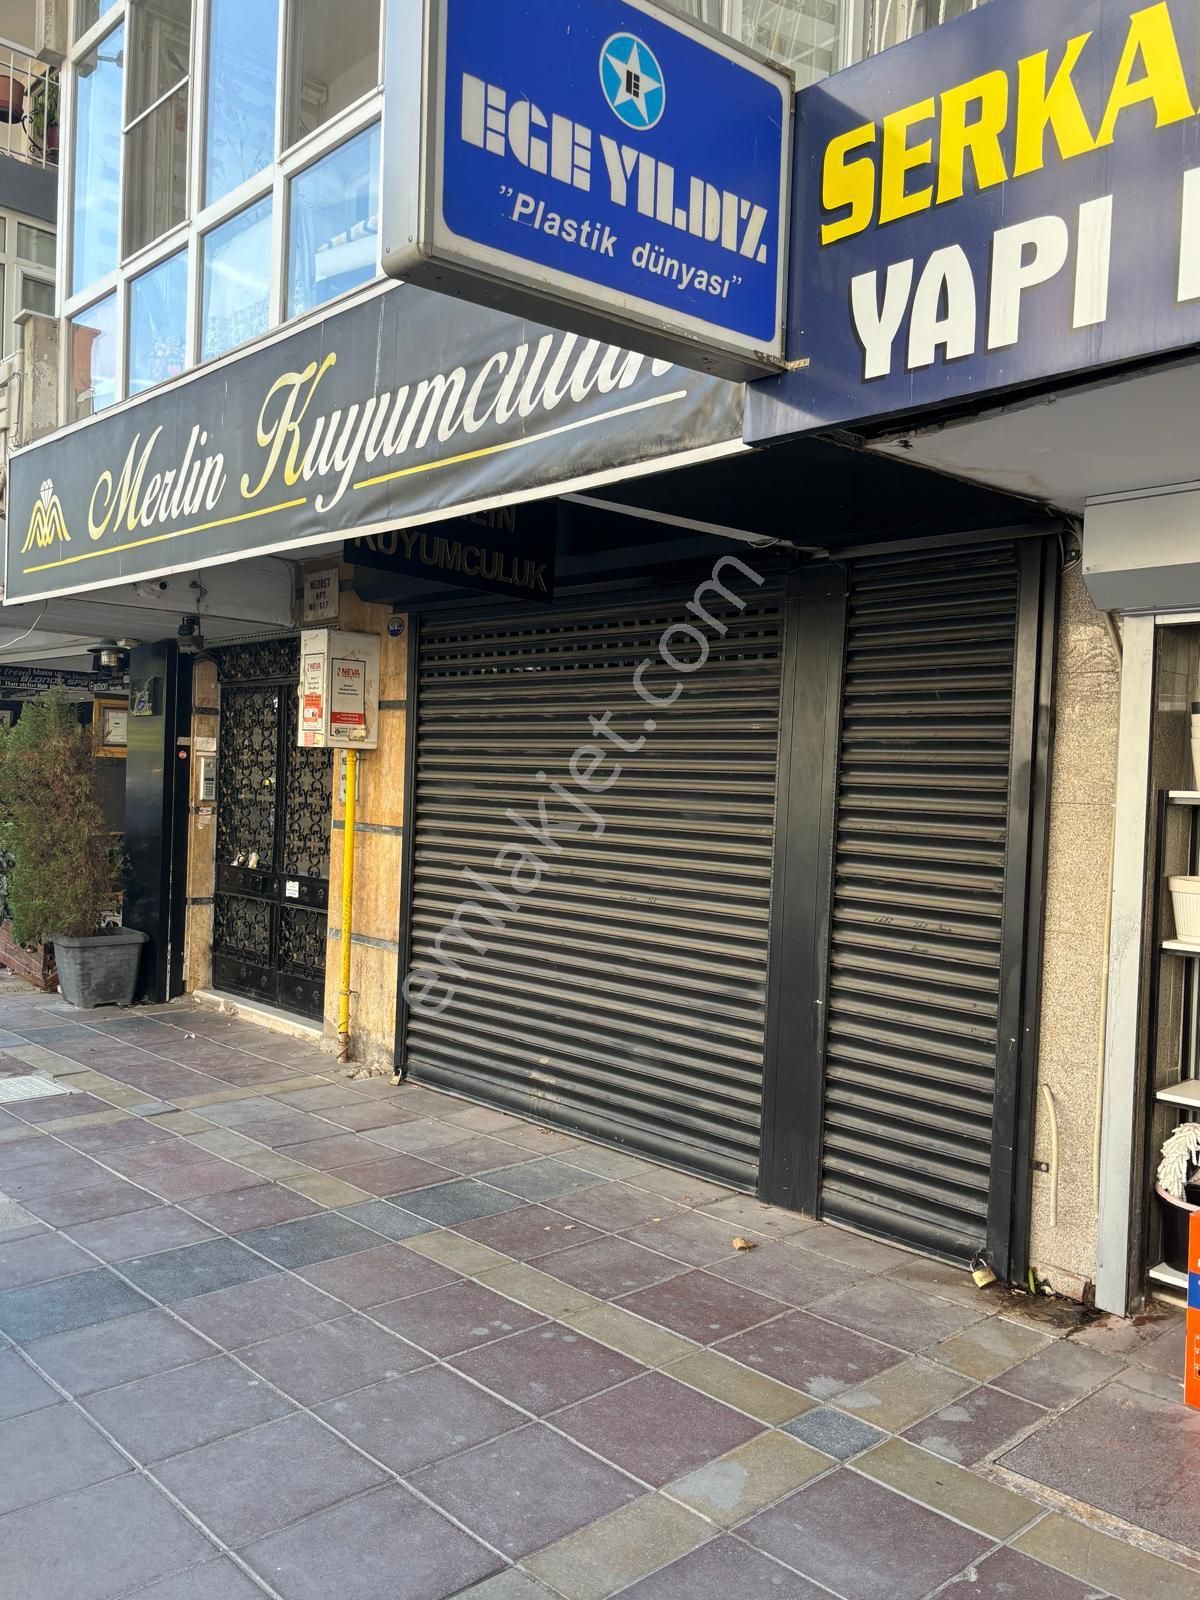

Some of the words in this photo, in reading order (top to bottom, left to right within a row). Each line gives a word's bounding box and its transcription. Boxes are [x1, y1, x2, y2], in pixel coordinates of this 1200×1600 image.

[461, 72, 592, 192] EGE
[599, 133, 768, 264] YILDIZ
[821, 1, 1200, 246] SERKA
[851, 194, 1113, 380] YAPI
[87, 424, 227, 541] Merlin
[341, 667, 360, 676] NEVA
